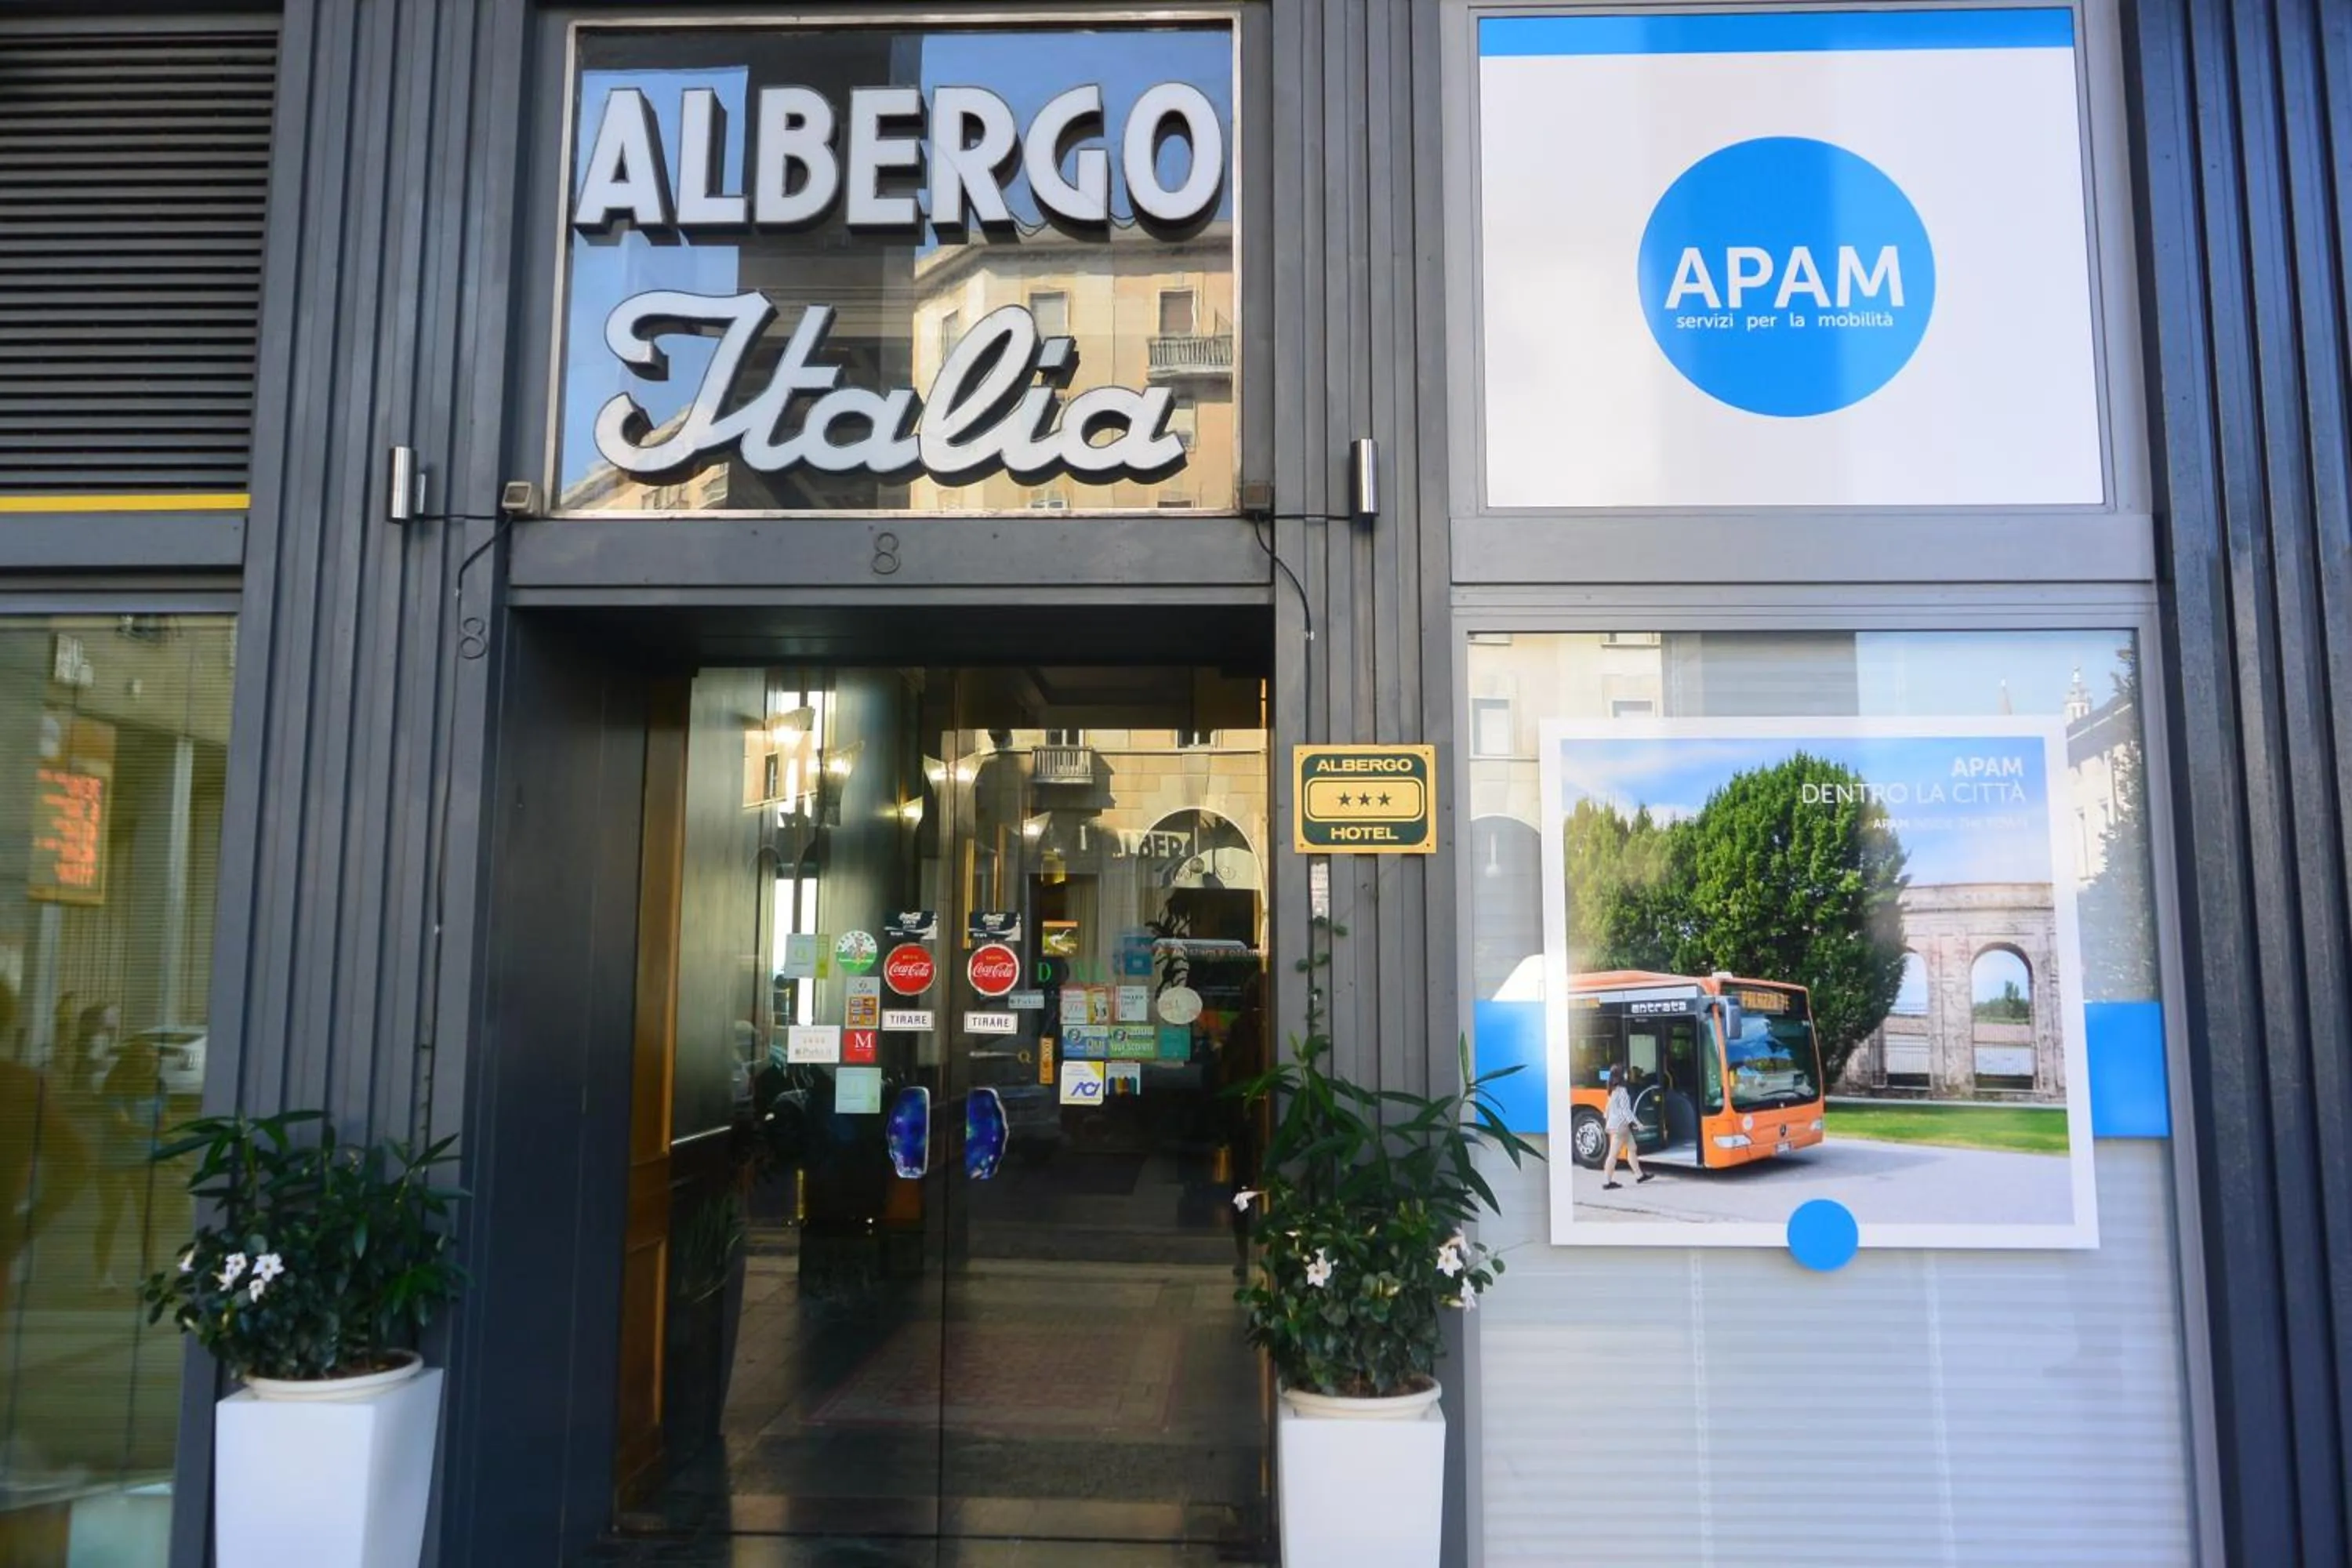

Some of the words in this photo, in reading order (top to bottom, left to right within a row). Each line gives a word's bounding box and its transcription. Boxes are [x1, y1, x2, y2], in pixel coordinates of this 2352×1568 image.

[574, 82, 1225, 235] ALBERGO
[1664, 245, 1905, 309] APAM
[1676, 314, 1733, 328] servizi
[1746, 314, 1777, 332] per
[1790, 313, 1805, 328] la
[1818, 310, 1894, 328] mobilità
[593, 290, 1187, 477] Italia
[871, 532, 901, 575] 8
[459, 617, 487, 660] 8
[1316, 759, 1413, 772] ALBERGO
[1951, 757, 2024, 777] APAM
[1802, 782, 1908, 804] DENTRO
[1915, 782, 1946, 804] LA
[1330, 827, 1399, 840] HOTEL
[1873, 818, 1910, 829] APAM
[890, 1014, 927, 1025] TIRARE
[971, 1017, 1010, 1028] TIRARE
[854, 1031, 873, 1049] M
[1071, 1081, 1102, 1097] ACI
